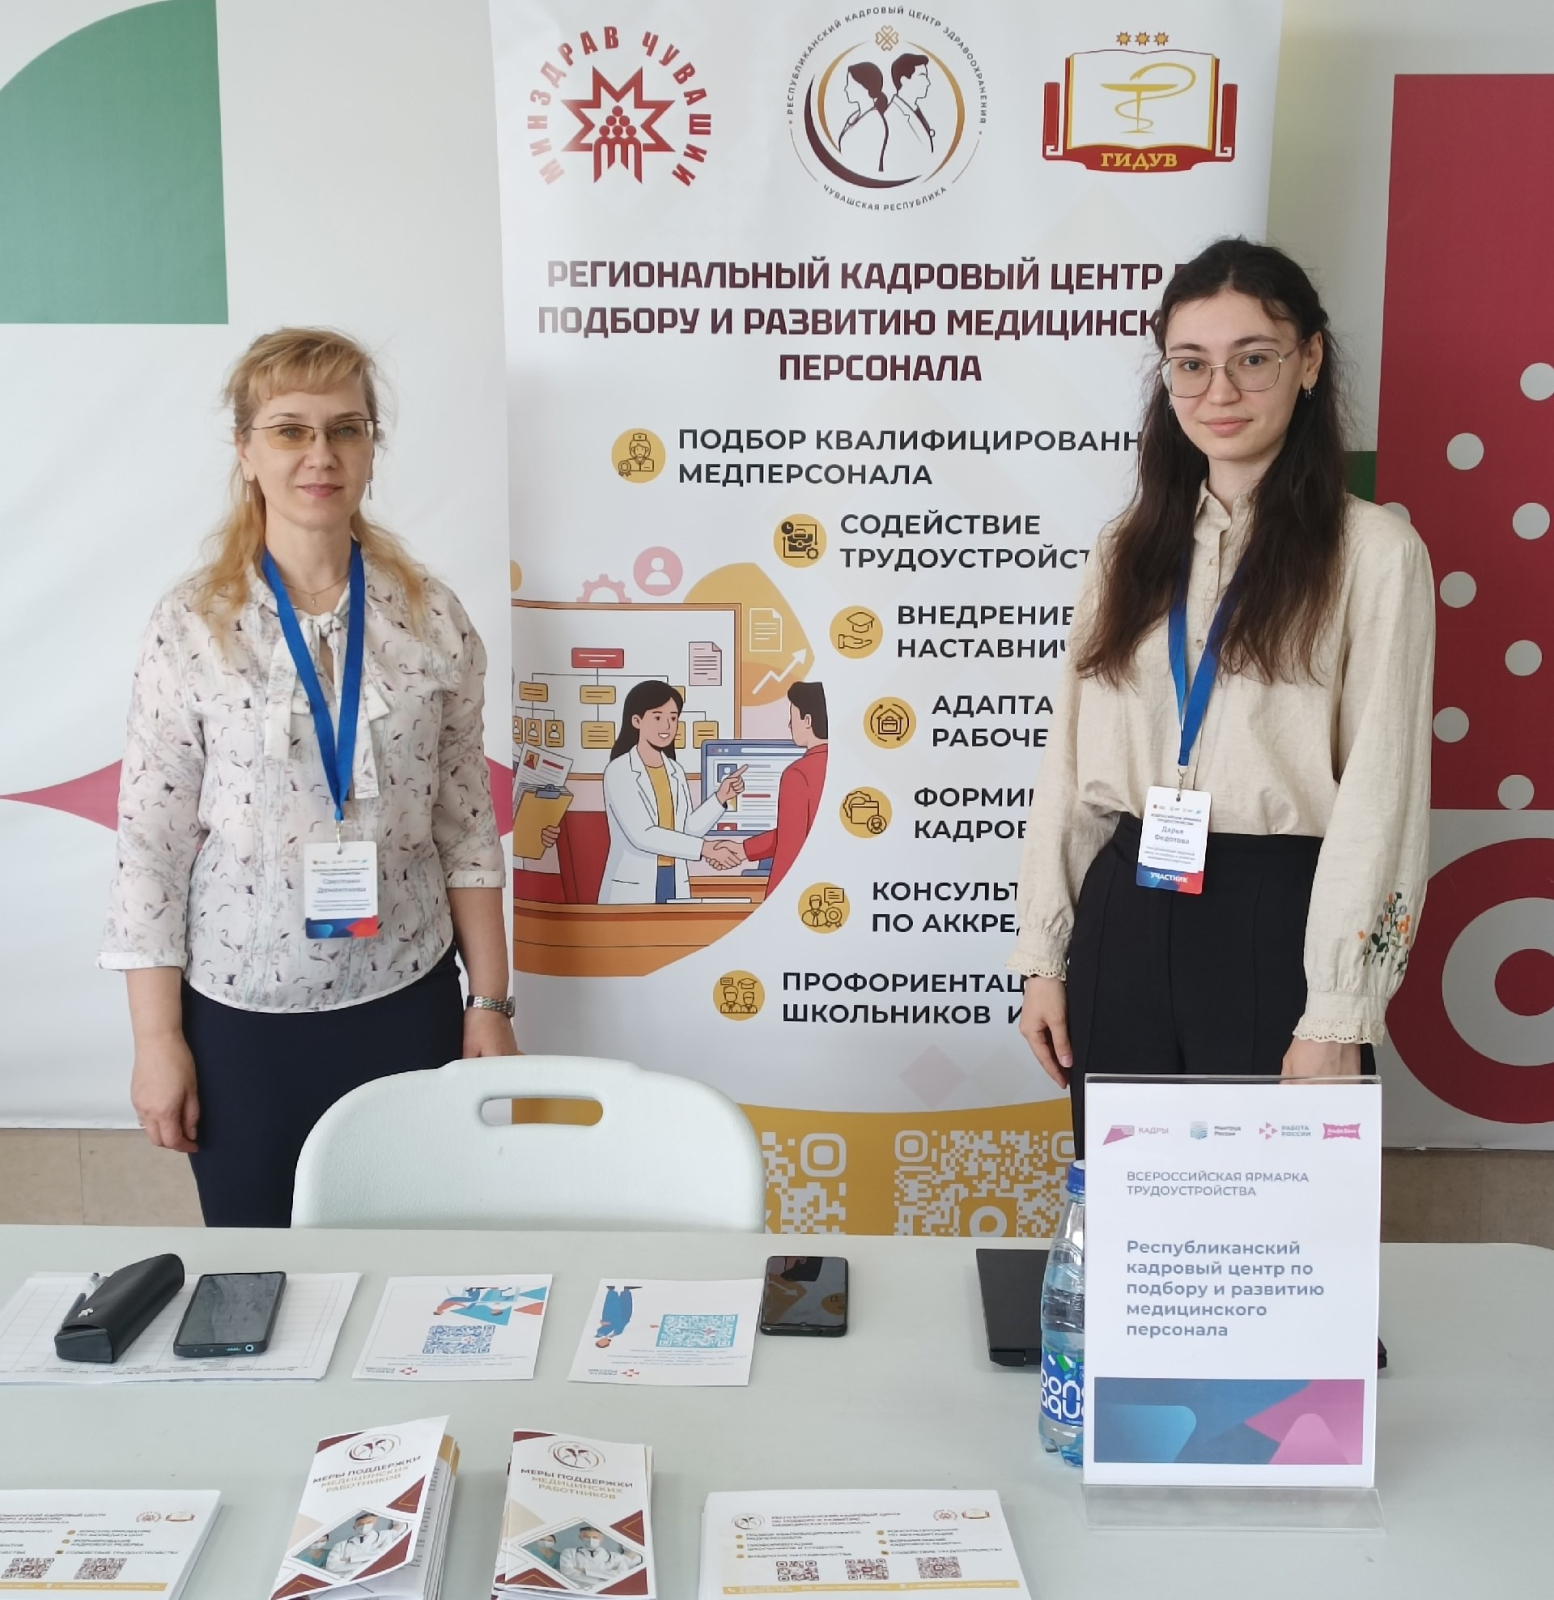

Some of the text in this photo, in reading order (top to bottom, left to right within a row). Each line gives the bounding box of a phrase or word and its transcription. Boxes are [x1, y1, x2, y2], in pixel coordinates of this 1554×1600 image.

[787, 6, 987, 124] РЕСПУБЛИКАНСКИЙ КАДРОВЫЙ ЦЕНТР ЗДРАВООХРАНЕНИЯ
[527, 26, 711, 186] МИНЗДРАВ ЧУВАШИИ
[1101, 153, 1178, 170] ГИДУВ
[823, 184, 947, 211] ЧУВАШСКАЯ РЕСПУБЛИКА
[547, 255, 1163, 294] РЕГИОНАЛЬНЫЙ КАДРОВЫЙ ЦЕНТР
[538, 307, 700, 338] ПОДБОРУ
[711, 308, 733, 334] И
[744, 308, 936, 336] РАЗВИТИЮ
[780, 354, 982, 381] ПЕРСОНАЛА
[678, 428, 1142, 453] ПОДБОР КВАЛИФИЦИРОВАНН
[678, 463, 933, 487] МЕДПЕРСОНАЛА
[840, 510, 1041, 538] СОДЕЙСТВИЕ
[897, 605, 1075, 629] ВНЕДРЕНИЕ
[931, 695, 1054, 718] АДАПТА
[932, 728, 1049, 748] РАБОЧЕ
[914, 787, 1035, 808] ФОРМИ
[872, 914, 1021, 937] ПО АККРЕ
[782, 972, 1025, 996] ПРОФОРИЕНТАЦ
[782, 1004, 991, 1024] ШКОЛЬНИКОВ
[1138, 1126, 1169, 1135] КАДРЫ
[1126, 1169, 1309, 1183] ВСЕРОССИЙСКАЯ ЯРМАРКА
[1126, 1184, 1257, 1197] ТРУДОУСТРОЙСТВА
[1127, 1240, 1301, 1257] Республиканский
[1126, 1261, 1314, 1278] кадровый центр по
[1126, 1281, 1325, 1298] подбору и развитию
[1126, 1302, 1267, 1317] медицинского
[1126, 1324, 1228, 1339] персонала
[1041, 1387, 1084, 1420] aqu
[313, 1455, 421, 1484] МЕРЫ ПОДДЕРЖКИ
[321, 1465, 410, 1488] МЕДИЦИНСКИХ
[520, 1468, 633, 1488] МЕРЫ ПОДДЕРЖКИ
[531, 1476, 623, 1494] МЕДИЦИНСКИХ
[538, 1484, 616, 1500] РАБОТНИКОВ
